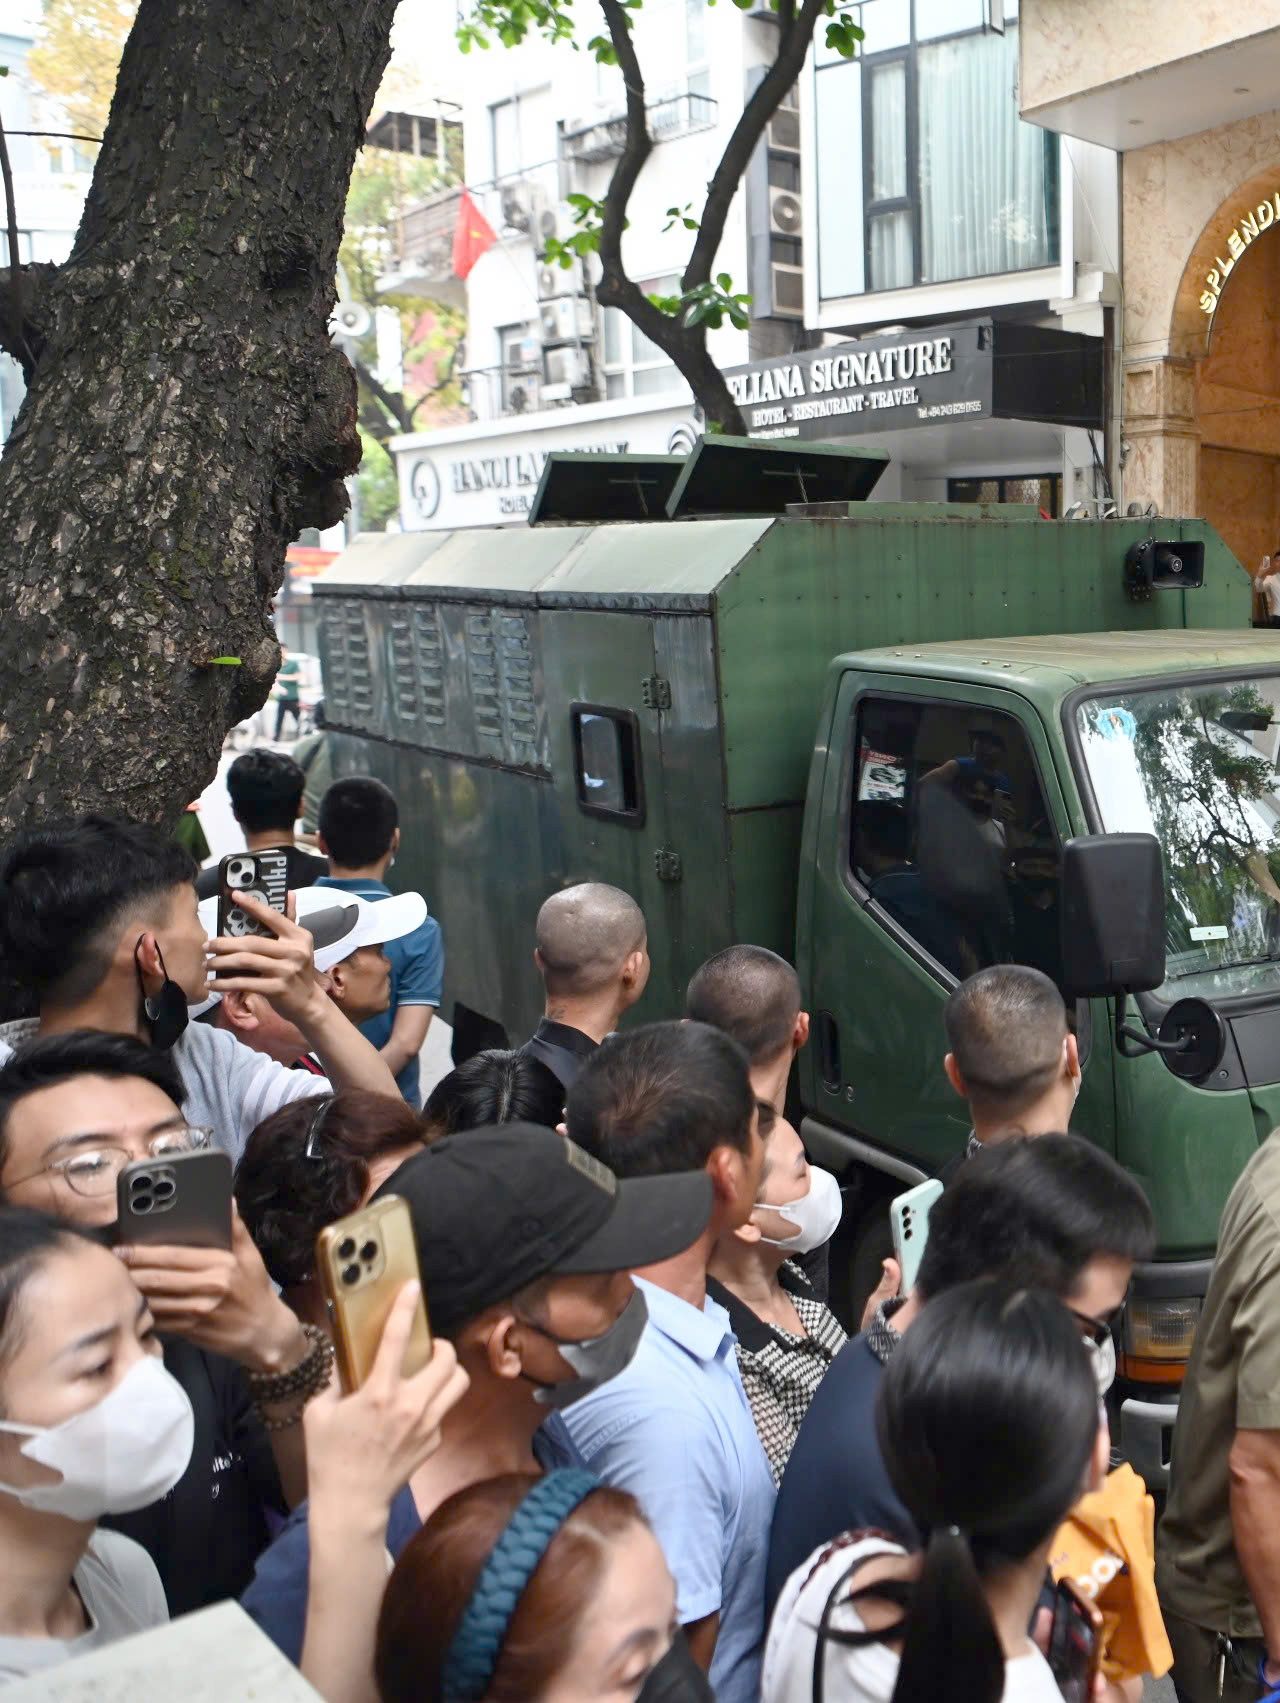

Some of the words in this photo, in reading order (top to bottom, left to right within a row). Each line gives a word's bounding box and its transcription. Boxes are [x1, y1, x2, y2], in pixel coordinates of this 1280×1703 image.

[725, 364, 806, 407] ELIANA
[810, 337, 952, 394] SIGNATURE
[752, 406, 788, 427] HOTEL
[793, 393, 866, 421] RESTAURANT
[870, 386, 919, 410] TRAVEL
